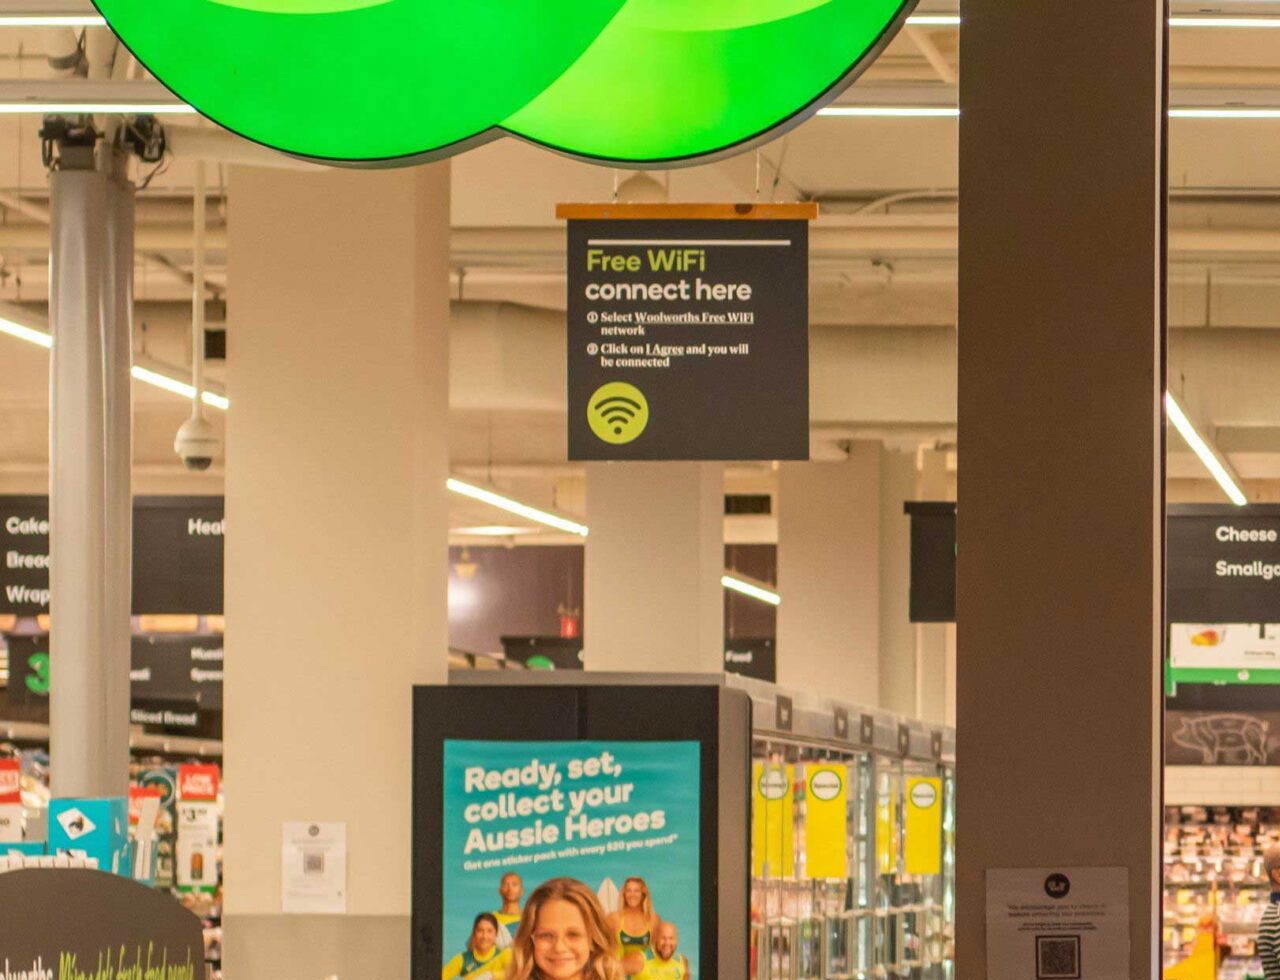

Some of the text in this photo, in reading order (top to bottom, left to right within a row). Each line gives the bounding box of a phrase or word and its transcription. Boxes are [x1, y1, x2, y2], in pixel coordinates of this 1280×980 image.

[587, 250, 705, 272] Free WiFi
[585, 278, 752, 301] connect here
[600, 311, 632, 323] Select
[634, 311, 700, 324] Woolworths
[701, 312, 727, 324] Free
[727, 312, 754, 324] WiFi
[600, 325, 646, 336] network
[600, 343, 629, 355] Click
[630, 345, 644, 355] on
[652, 343, 684, 357] Agree
[686, 344, 706, 355] and
[707, 346, 729, 357] you
[729, 343, 749, 354] will
[600, 356, 671, 367] be connected
[1215, 525, 1278, 542] Cheese
[464, 752, 622, 793] Ready, set,
[464, 783, 634, 823] collect your
[464, 810, 666, 855] Aussie Heroes
